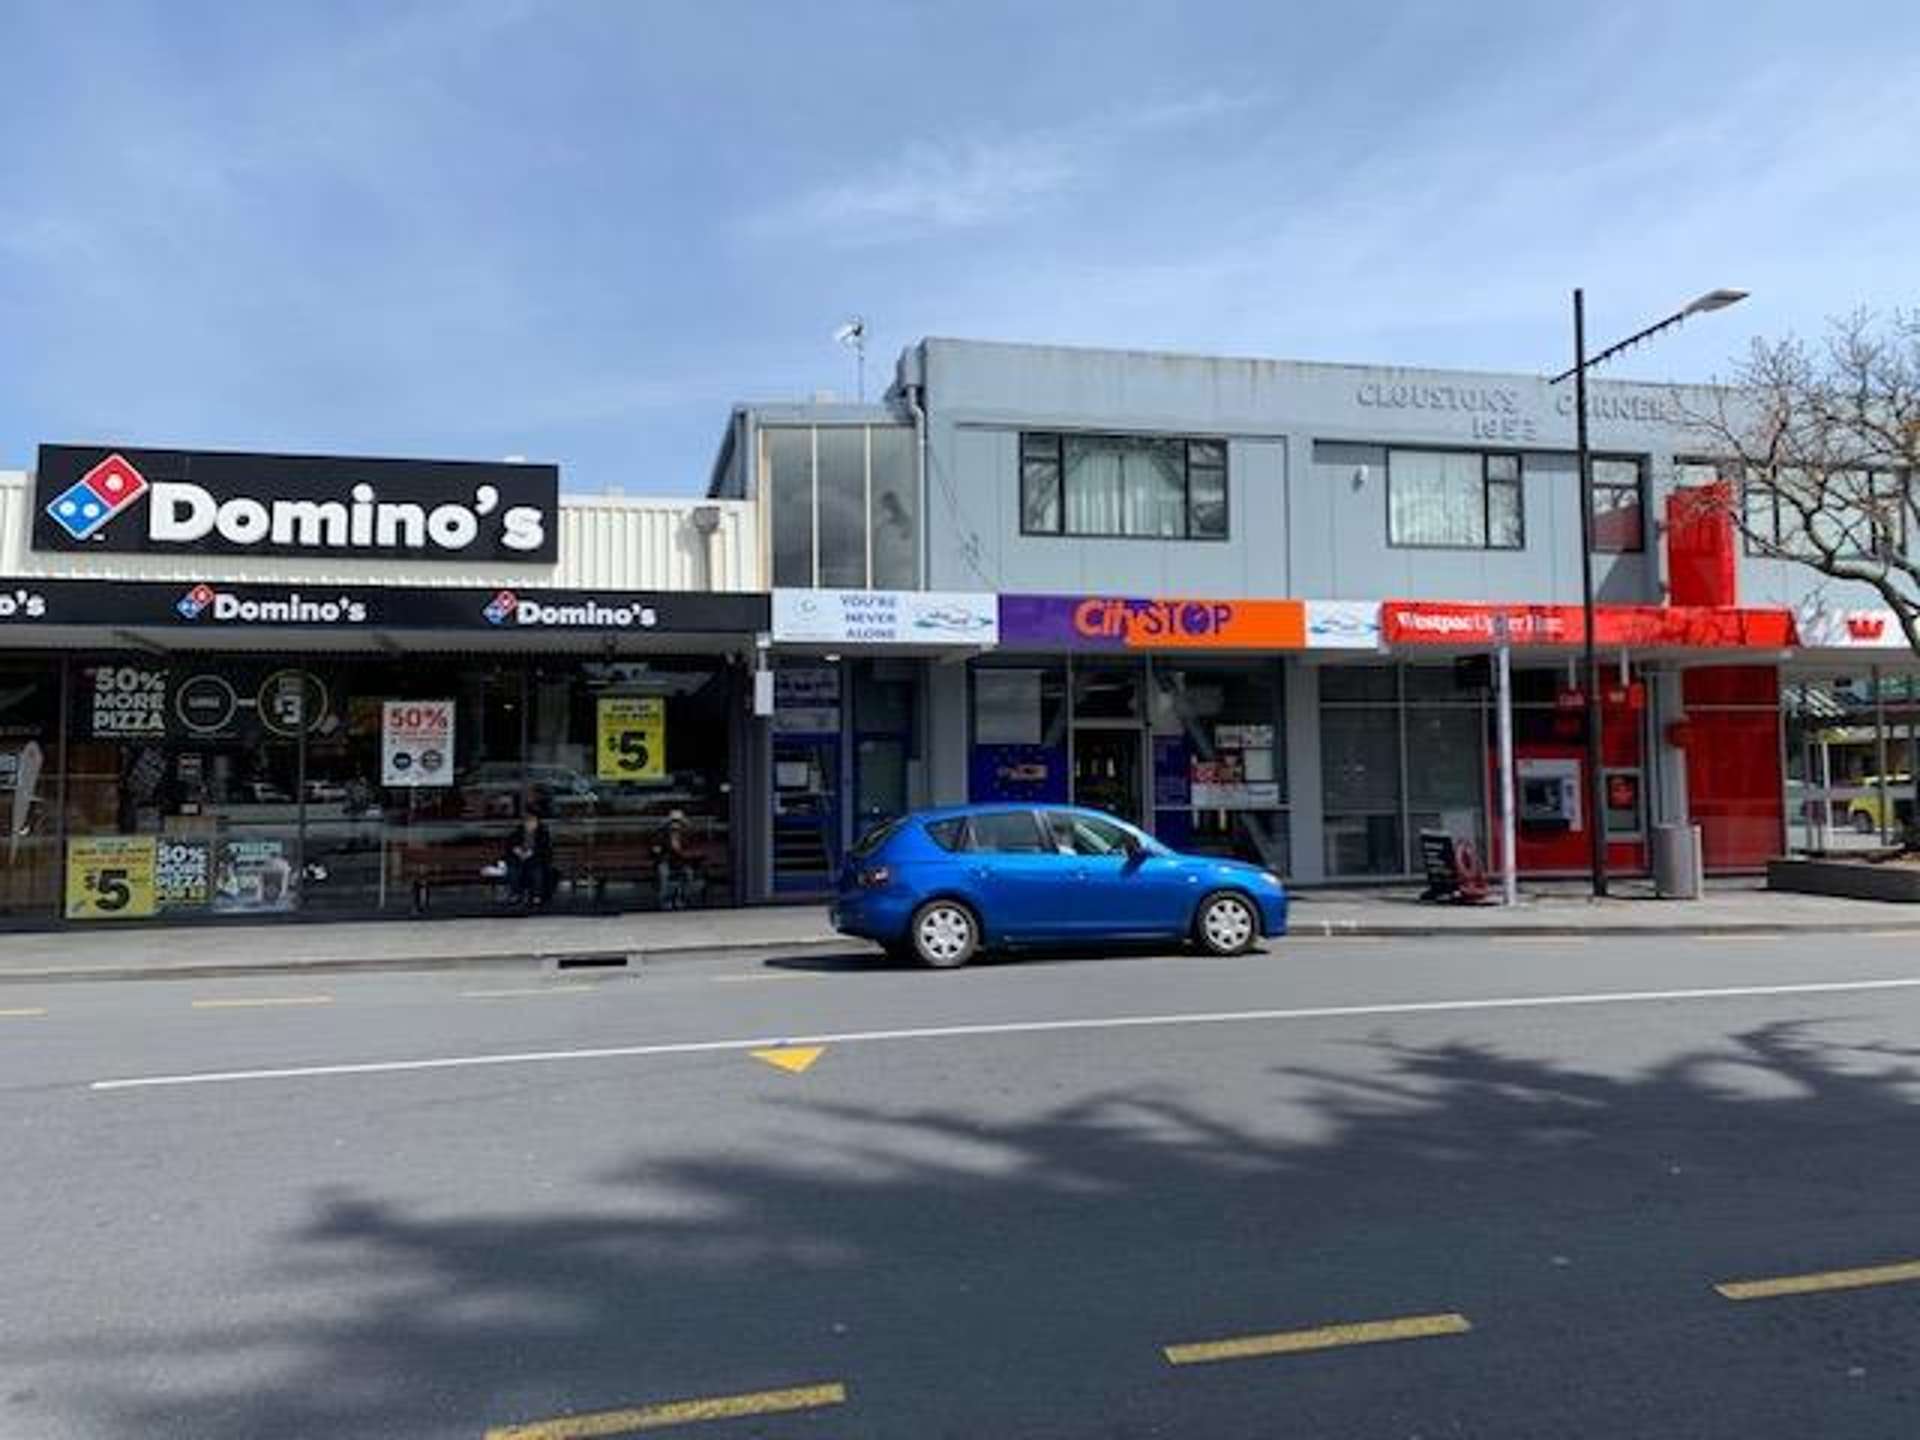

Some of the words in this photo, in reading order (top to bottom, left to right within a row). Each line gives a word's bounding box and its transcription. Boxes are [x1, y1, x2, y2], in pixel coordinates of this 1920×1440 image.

[149, 482, 545, 550] Domino's
[214, 594, 367, 622] Domino's
[518, 600, 657, 627] Domino's
[845, 612, 897, 625] NEVER
[1397, 611, 1475, 633] Westpac
[95, 692, 165, 710] MORE
[93, 710, 165, 730] PIZZA
[390, 708, 448, 730] 50%
[608, 731, 649, 772] $5
[84, 869, 131, 911] $5
